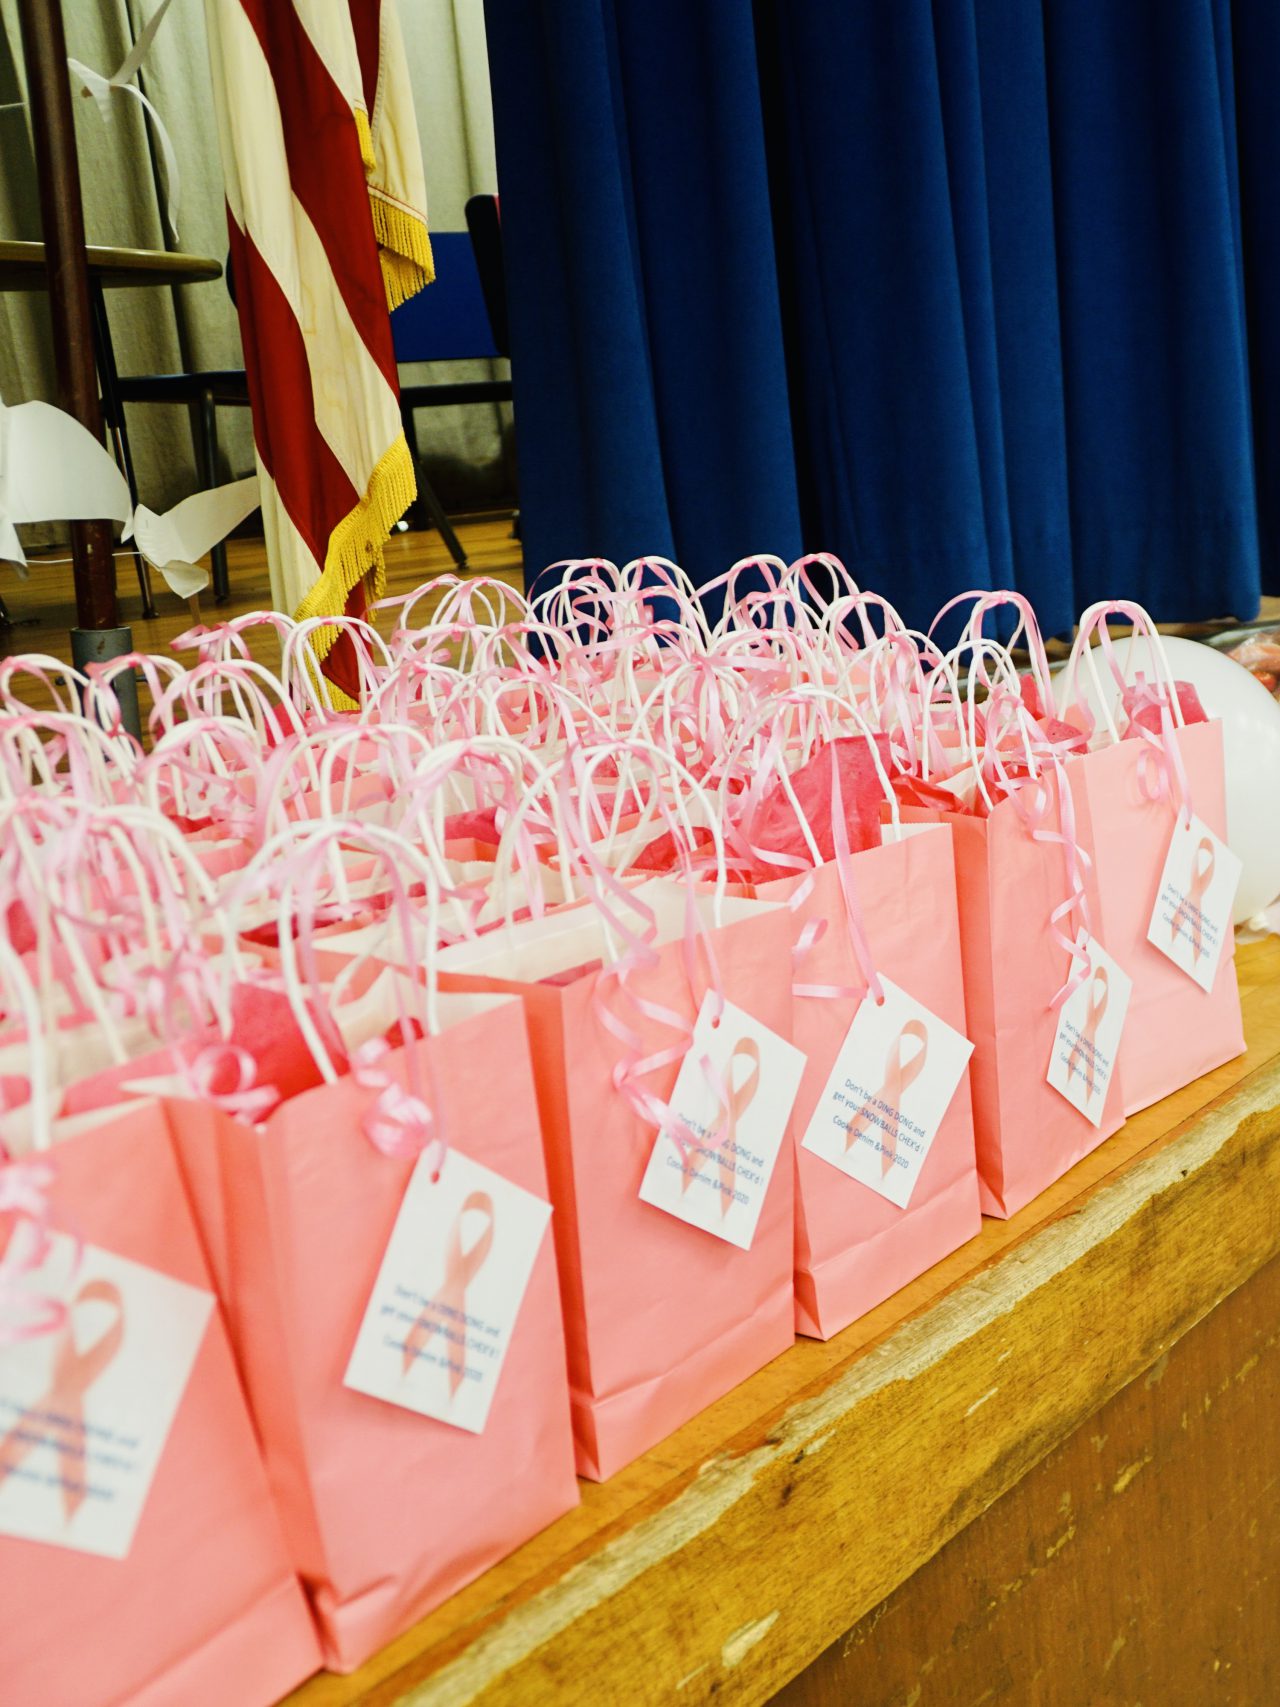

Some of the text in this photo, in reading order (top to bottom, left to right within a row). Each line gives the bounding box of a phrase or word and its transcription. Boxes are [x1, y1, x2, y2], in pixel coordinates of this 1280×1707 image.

[832, 1089, 845, 1104] get
[859, 1106, 898, 1137] SNOWBALLS
[844, 1078, 863, 1096] Don't
[863, 1091, 872, 1102] be
[876, 1100, 894, 1117] DING
[893, 1111, 913, 1129] DONG
[912, 1124, 925, 1137] and
[853, 1127, 875, 1147] Denim
[892, 1153, 909, 1169] 2020
